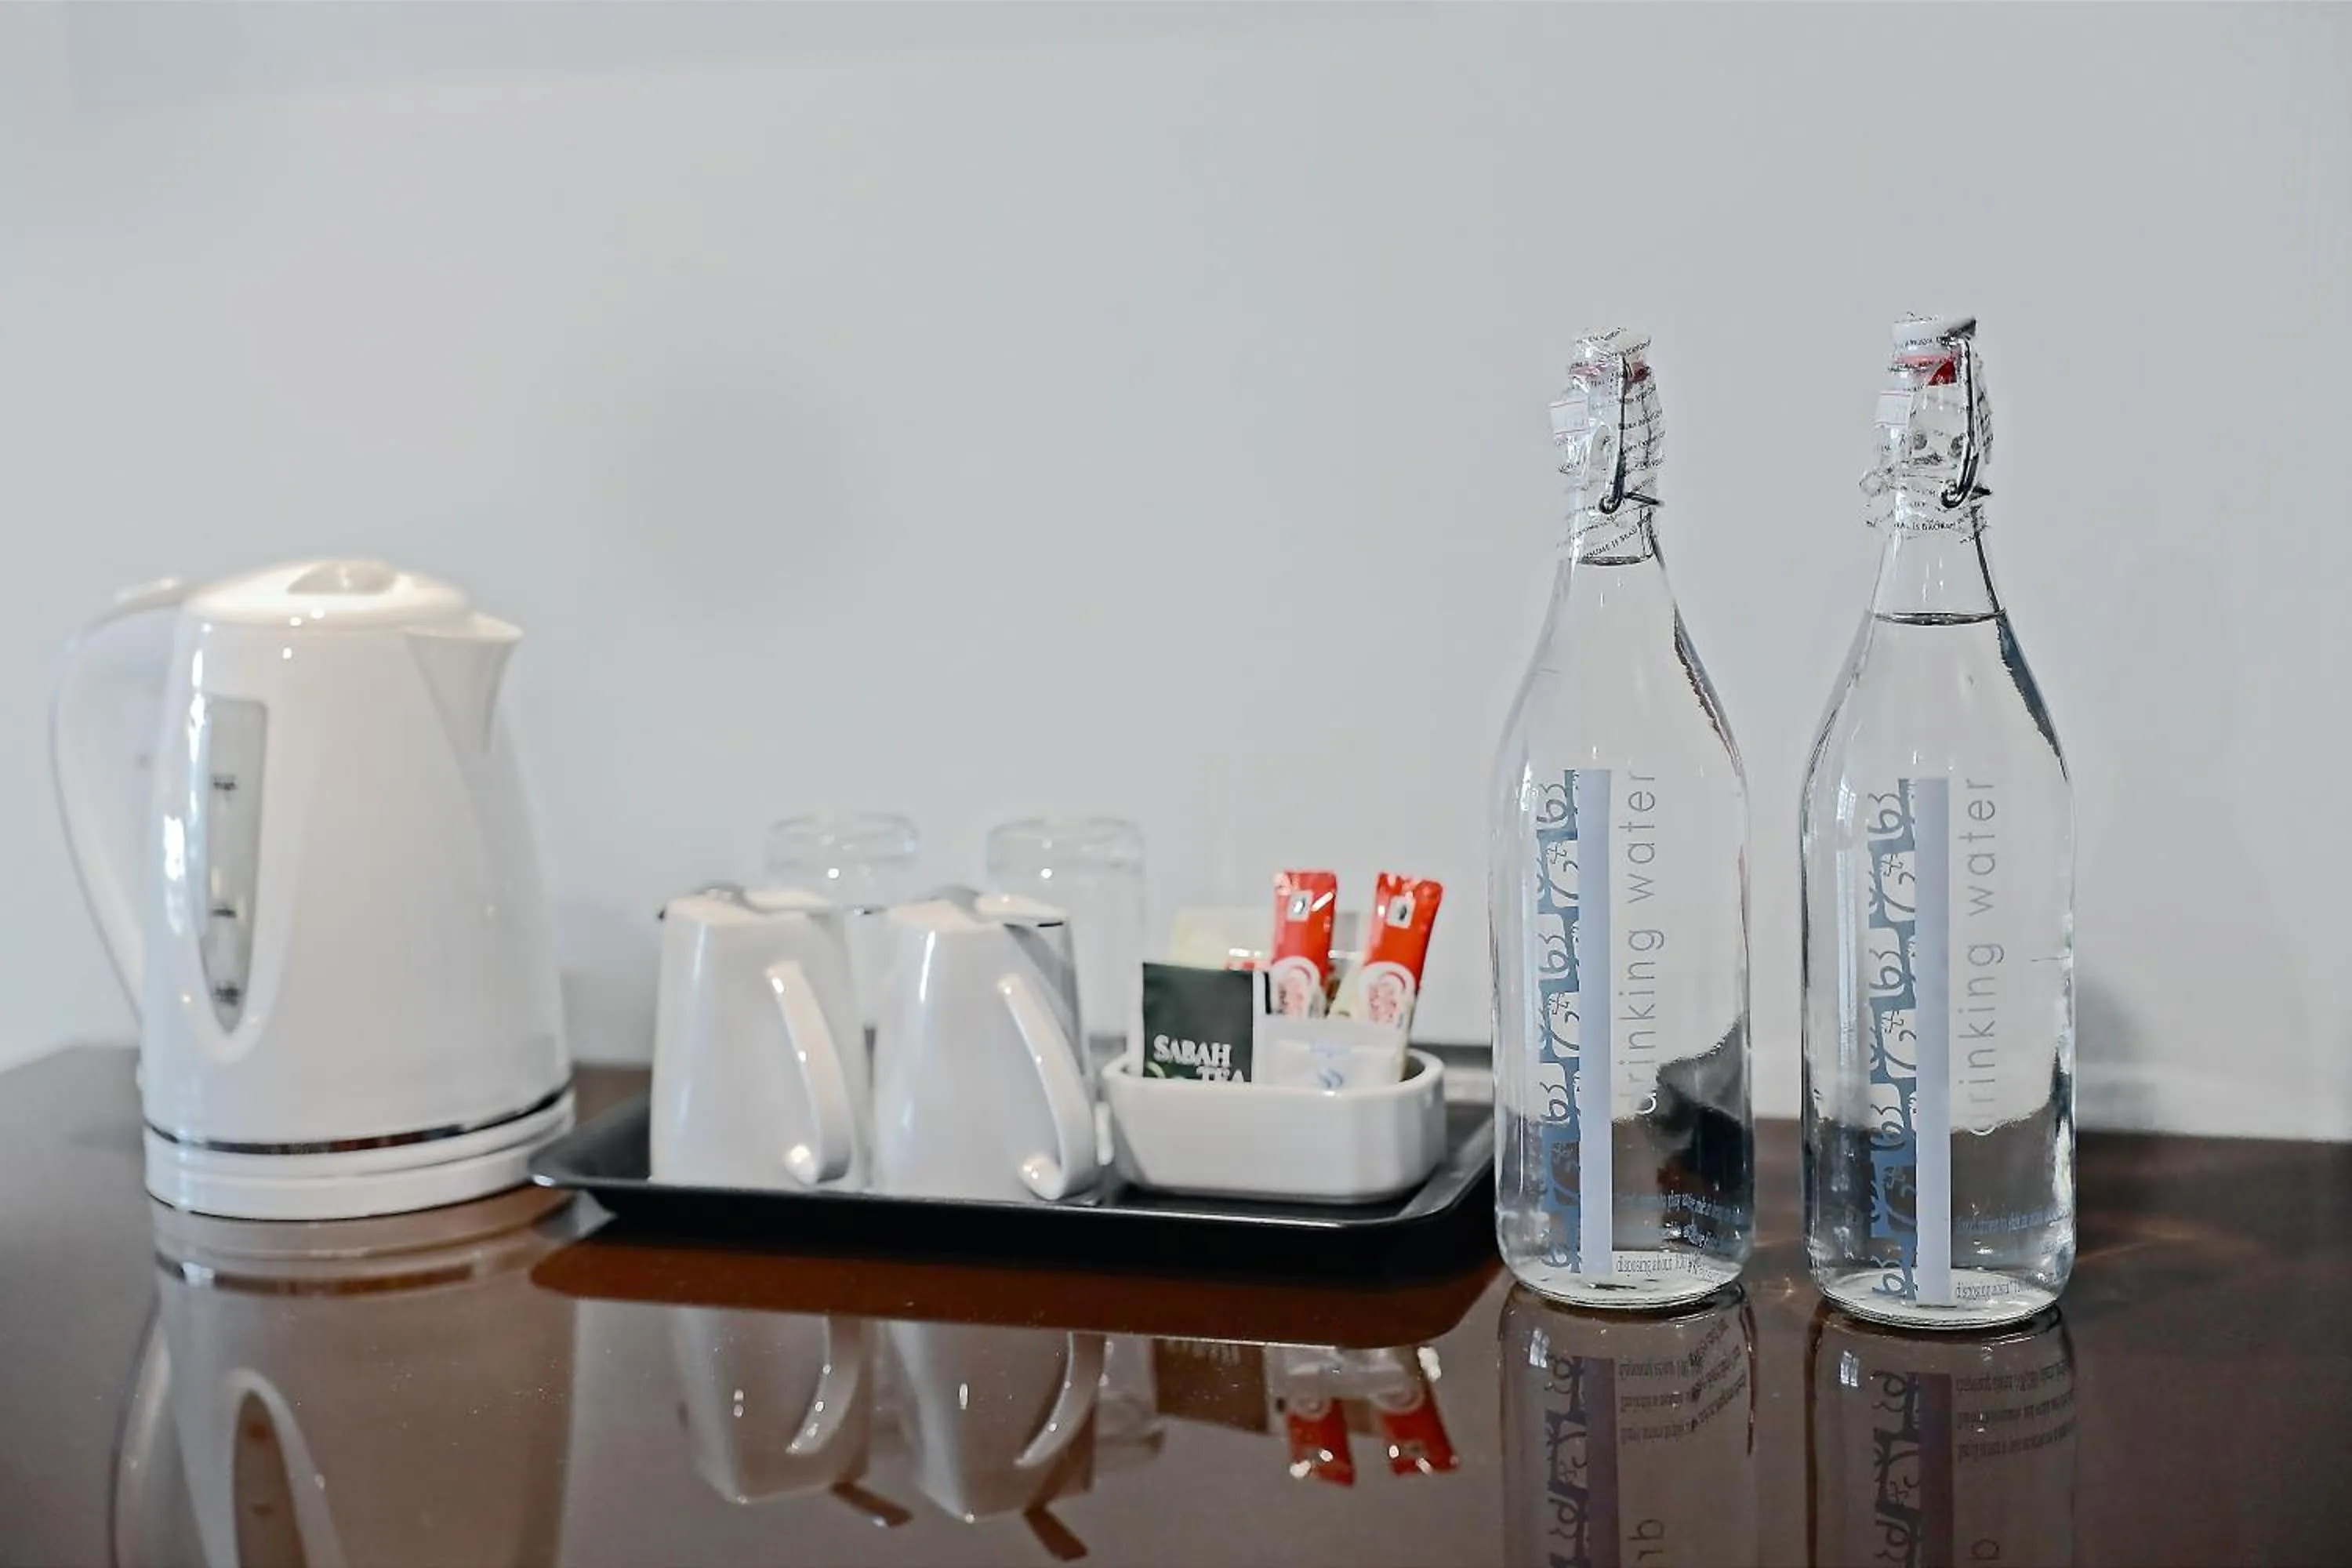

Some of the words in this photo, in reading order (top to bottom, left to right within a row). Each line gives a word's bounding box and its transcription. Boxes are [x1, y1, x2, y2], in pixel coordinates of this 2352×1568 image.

[1618, 771, 1656, 904] water
[1958, 779, 1996, 916] water
[1152, 1034, 1232, 1067] SABAH
